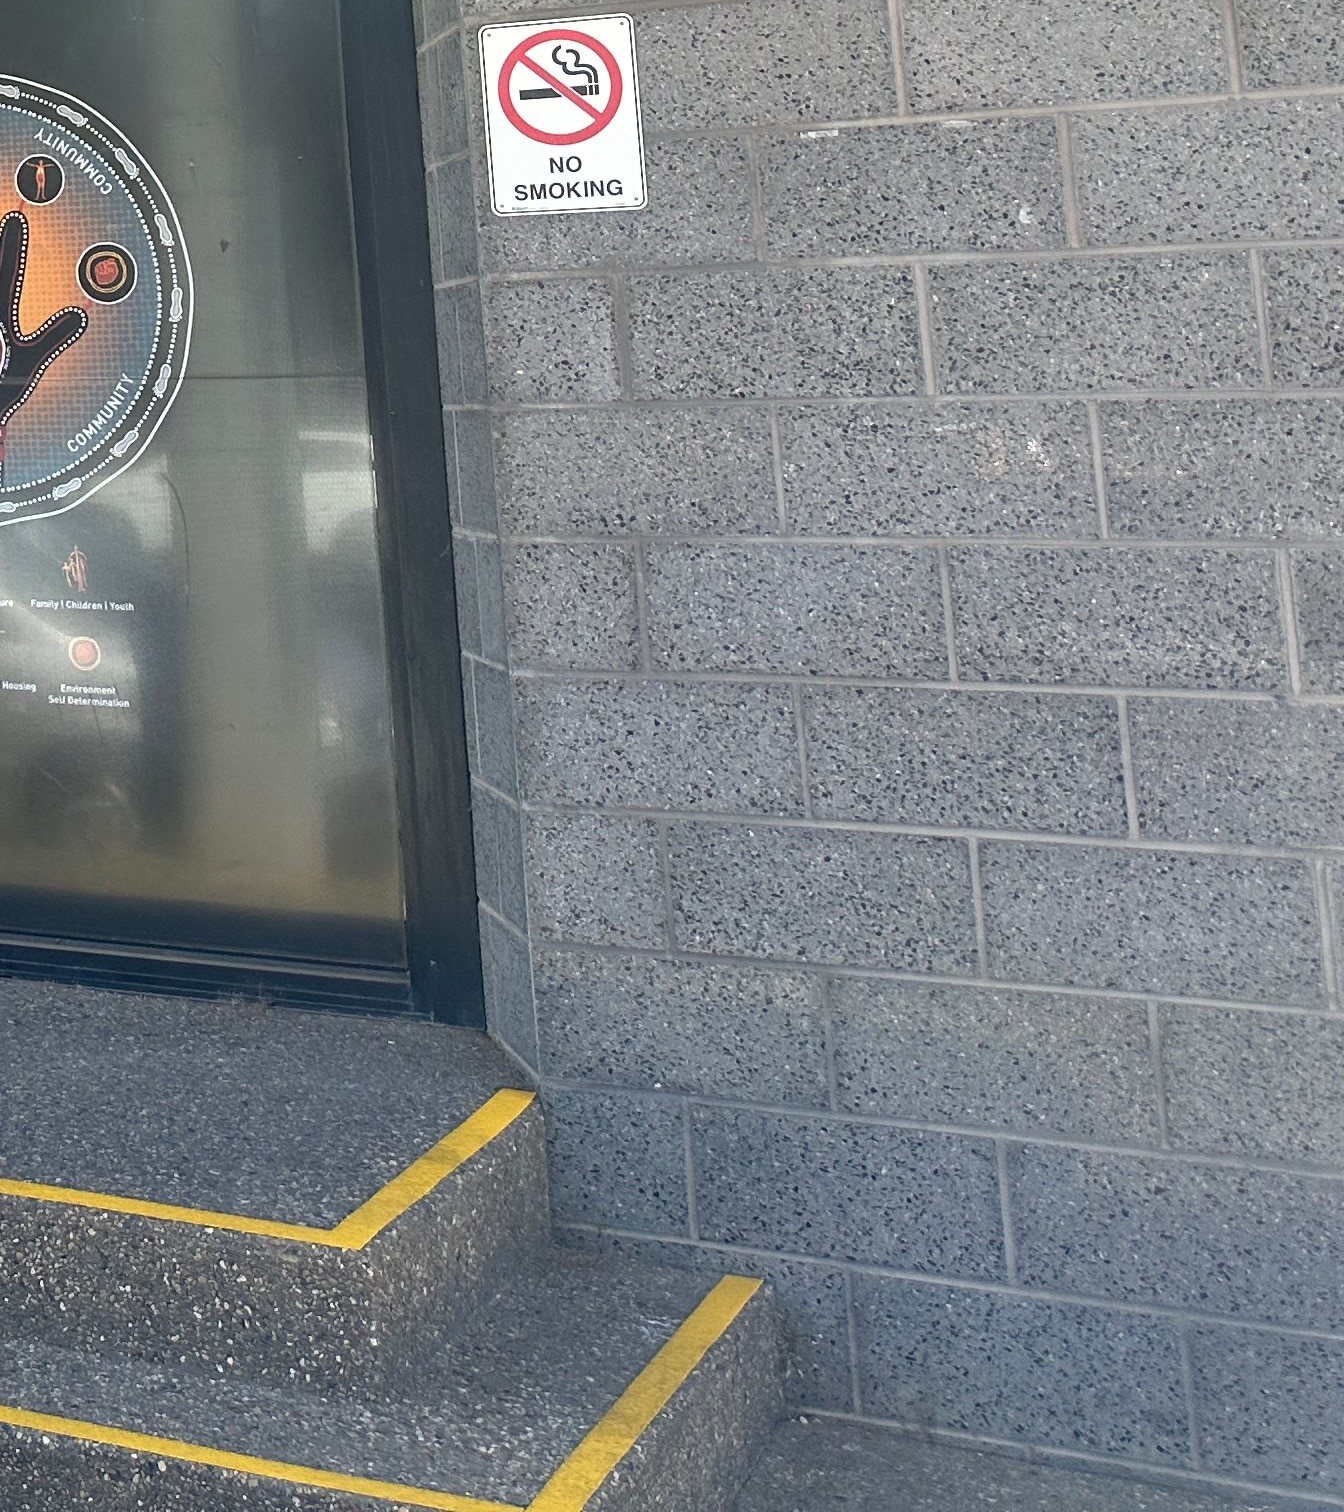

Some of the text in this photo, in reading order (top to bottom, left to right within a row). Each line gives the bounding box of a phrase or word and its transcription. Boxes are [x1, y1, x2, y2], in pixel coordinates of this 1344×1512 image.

[33, 127, 113, 195] COMMUNITY
[549, 155, 582, 174] NO
[514, 179, 624, 201] SMOKING
[67, 372, 134, 452] COMMUNITY
[30, 599, 59, 611] Family
[65, 600, 103, 610] Children
[109, 601, 135, 611] Youth
